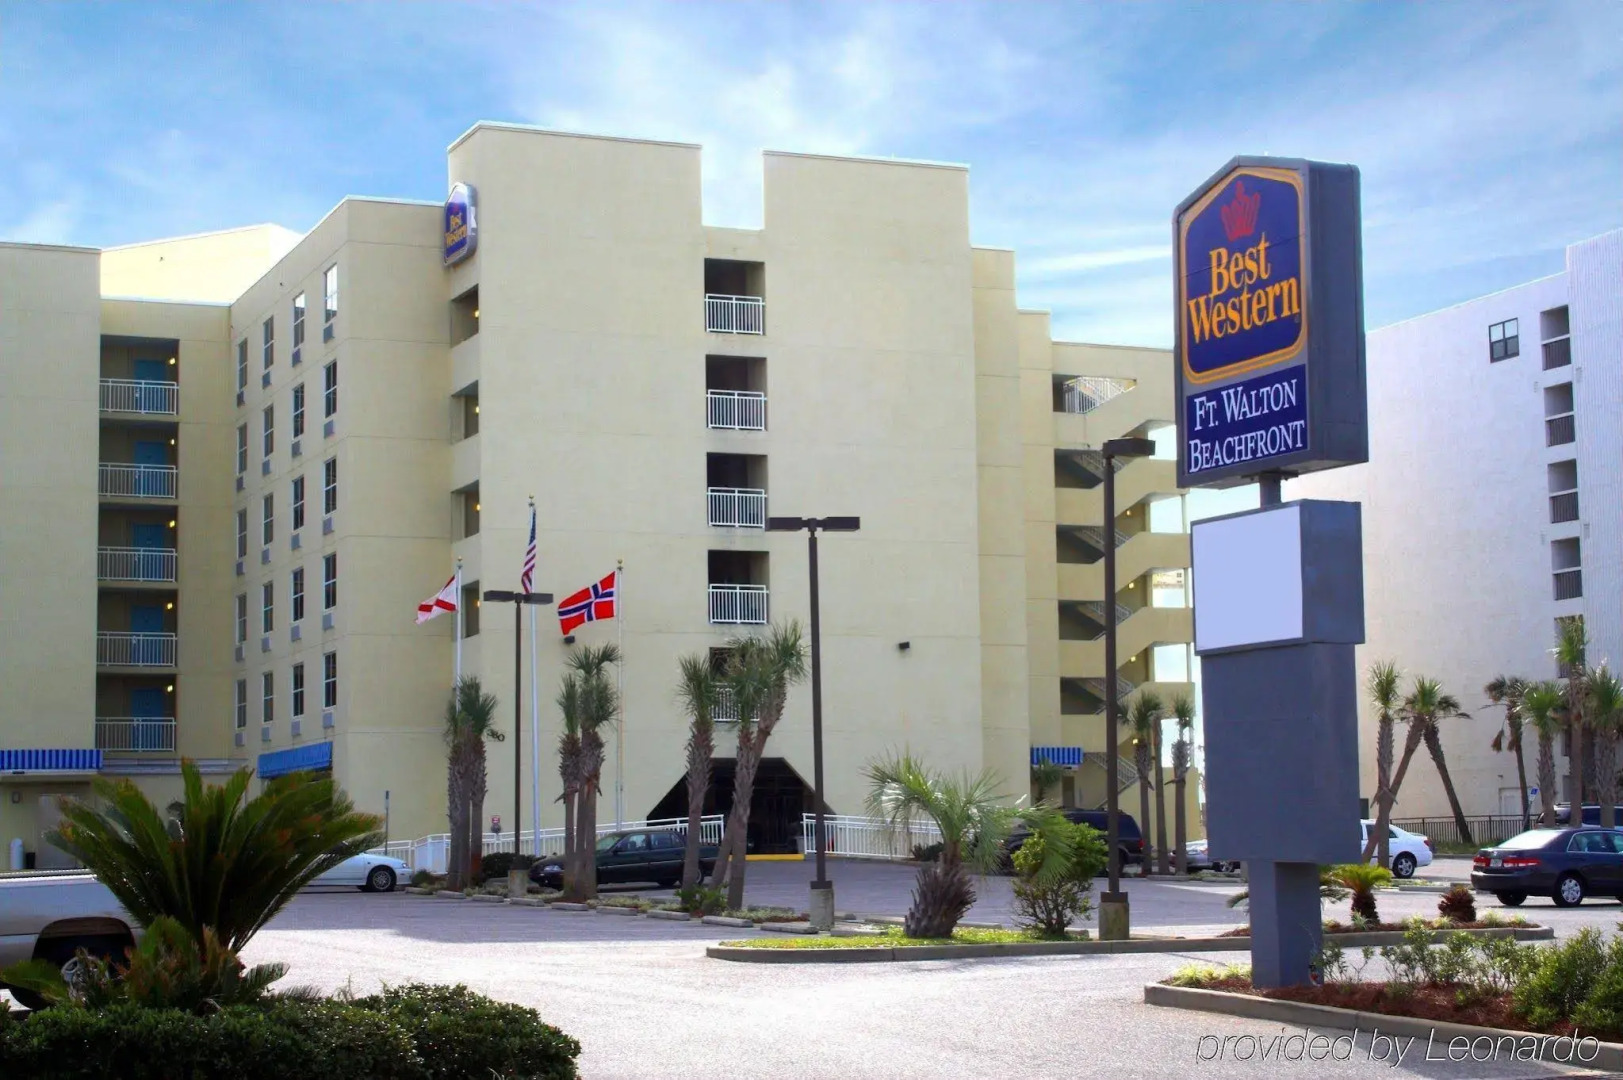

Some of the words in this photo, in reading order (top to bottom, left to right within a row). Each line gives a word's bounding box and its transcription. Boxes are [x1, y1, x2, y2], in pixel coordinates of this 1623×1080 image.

[1209, 232, 1270, 296] Best
[1188, 277, 1300, 344] Western
[1221, 379, 1297, 423] WALTON
[1189, 420, 1304, 472] BEACHFRONT
